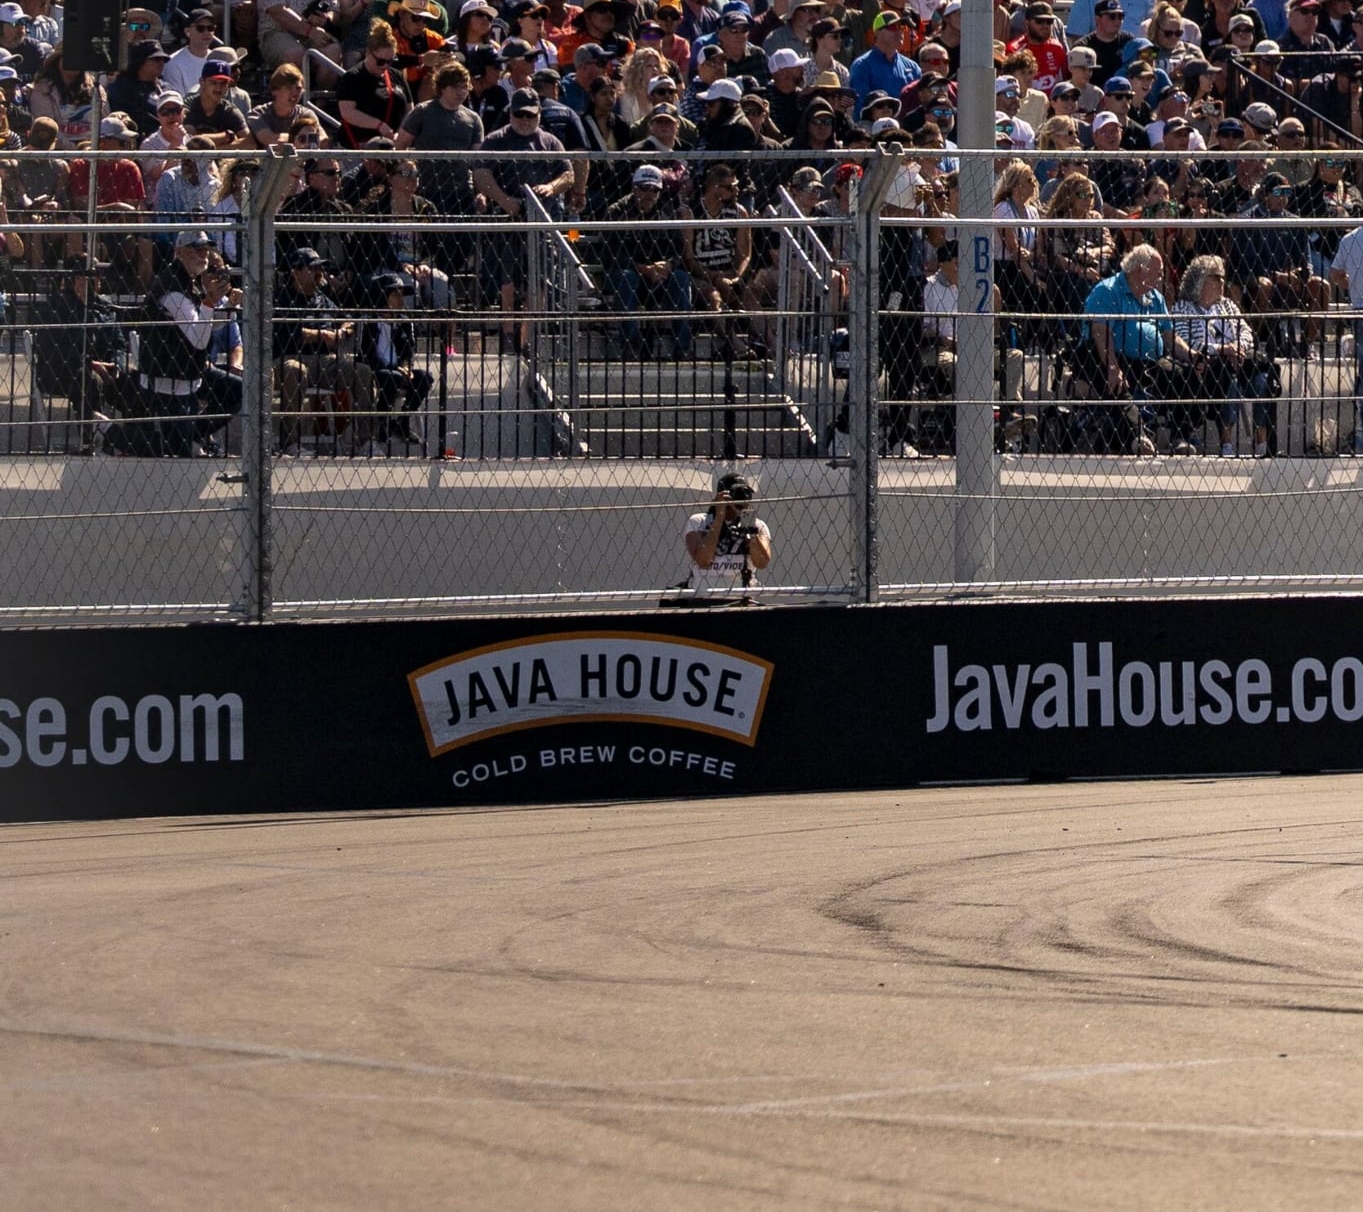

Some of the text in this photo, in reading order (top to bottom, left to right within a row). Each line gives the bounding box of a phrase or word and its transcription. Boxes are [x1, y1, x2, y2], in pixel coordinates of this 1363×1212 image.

[443, 653, 742, 726] JAVA HOUSE
[452, 745, 737, 788] COLD BREW COFFEE
